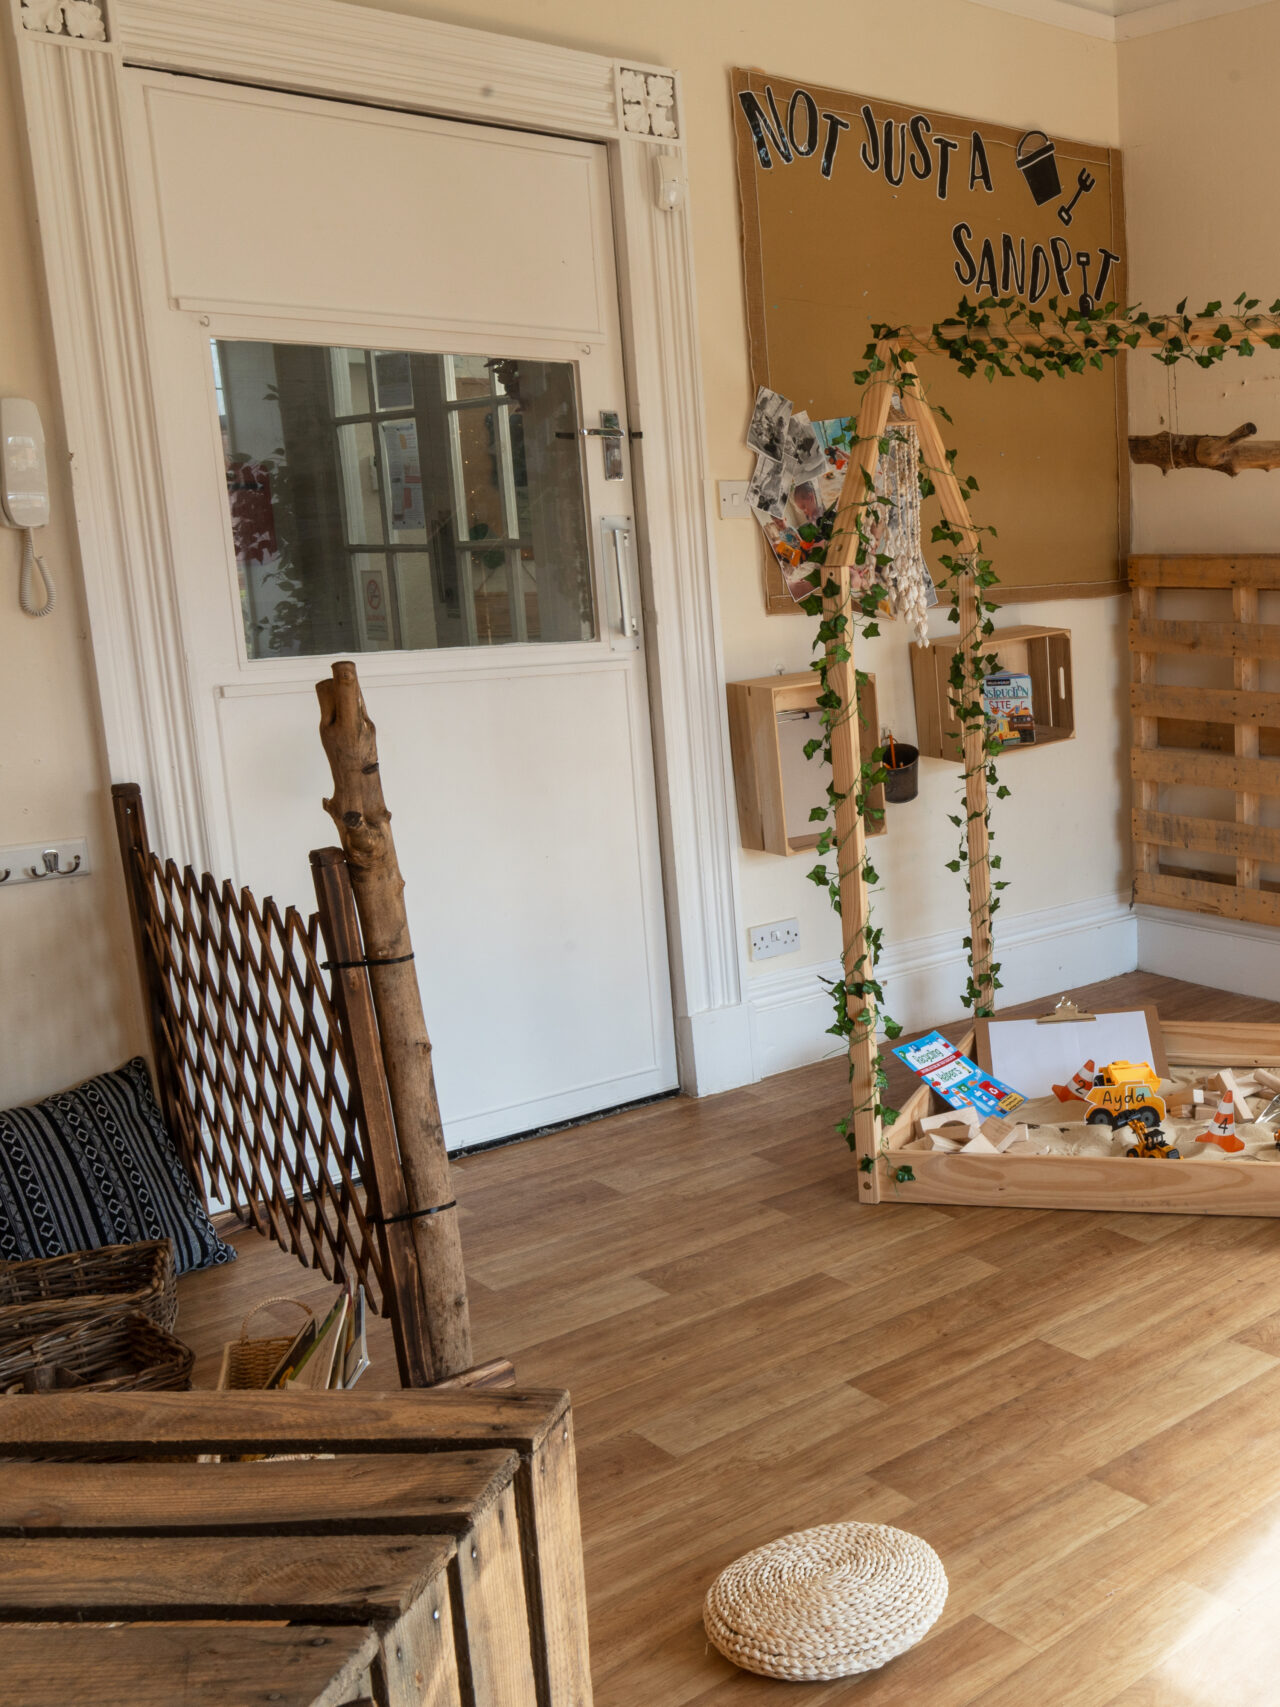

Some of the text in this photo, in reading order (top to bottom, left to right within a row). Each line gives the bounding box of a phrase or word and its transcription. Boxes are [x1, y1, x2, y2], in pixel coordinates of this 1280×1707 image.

[738, 84, 994, 200] NOT JUST A
[1075, 1079, 1087, 1095] 2
[1102, 1088, 1146, 1112] Ayda
[1218, 1117, 1229, 1134] 4
